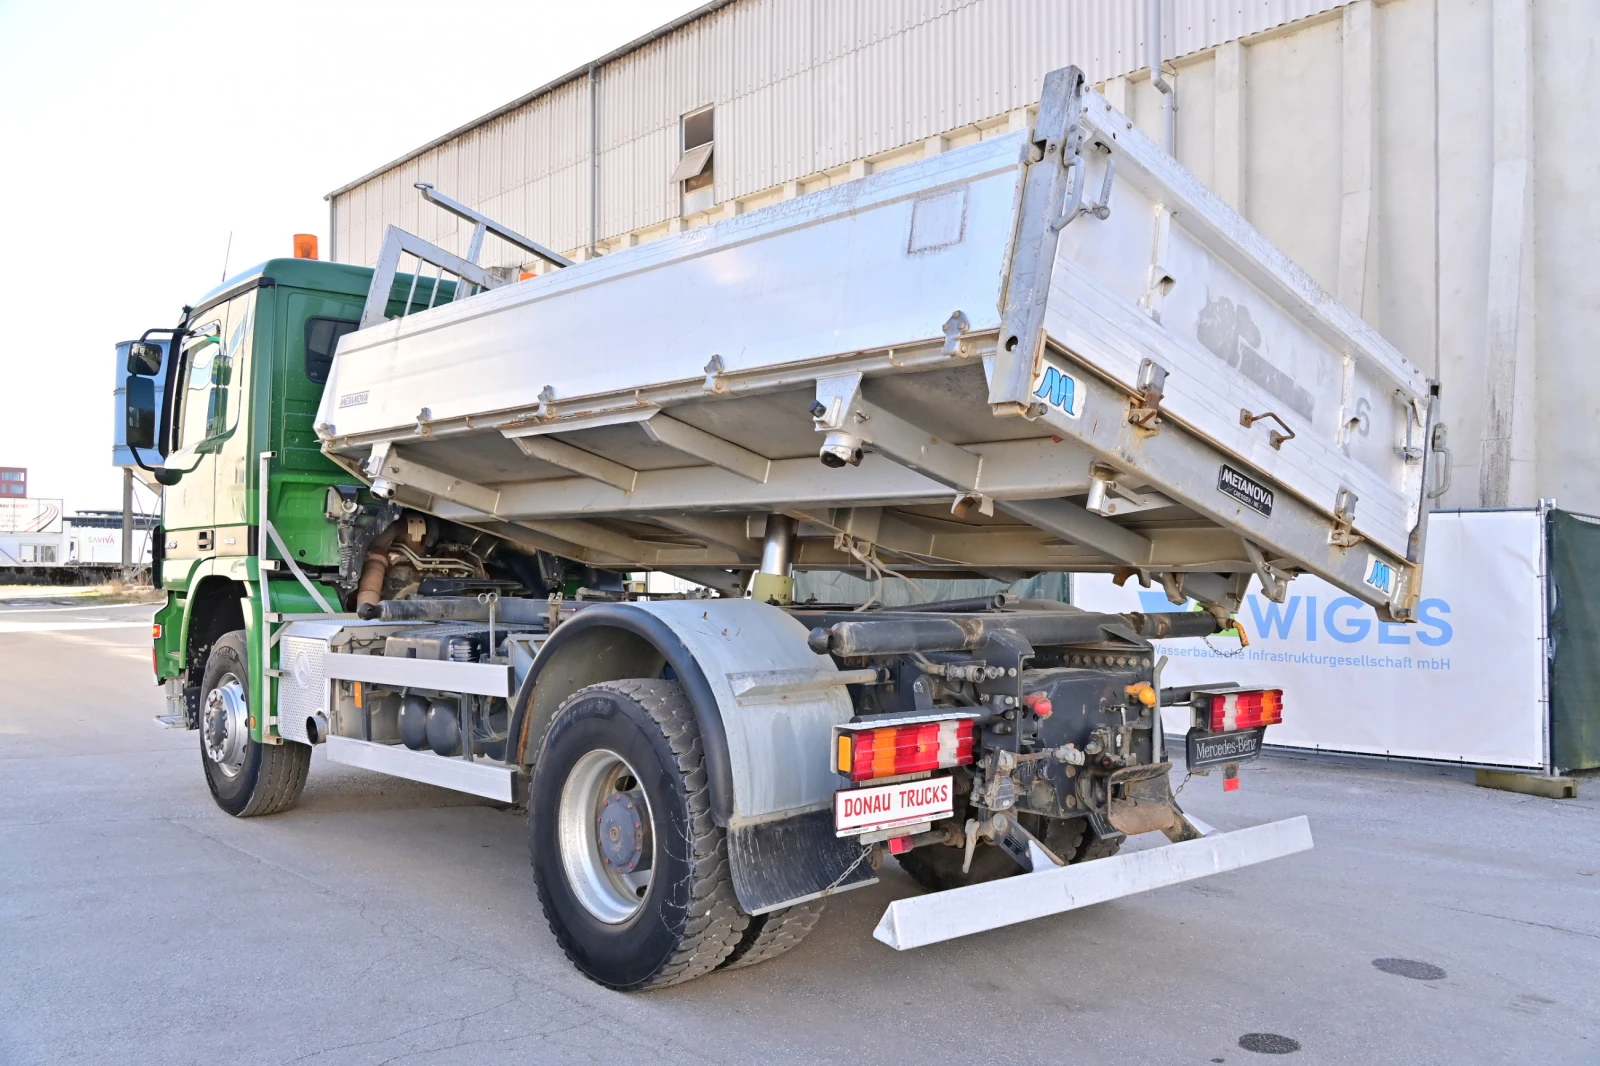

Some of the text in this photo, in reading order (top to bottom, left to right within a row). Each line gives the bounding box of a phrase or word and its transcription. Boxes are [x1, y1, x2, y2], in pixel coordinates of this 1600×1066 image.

[1222, 468, 1272, 508] METANOVA
[88, 534, 115, 544] SAVIVA
[1246, 594, 1453, 646] WIGES
[1249, 649, 1412, 668] Infrastrukturgesellschaft
[1417, 658, 1451, 670] mbH
[1196, 737, 1257, 760] Mercedes-Benz
[844, 785, 948, 817] DONAU TRUCKS
